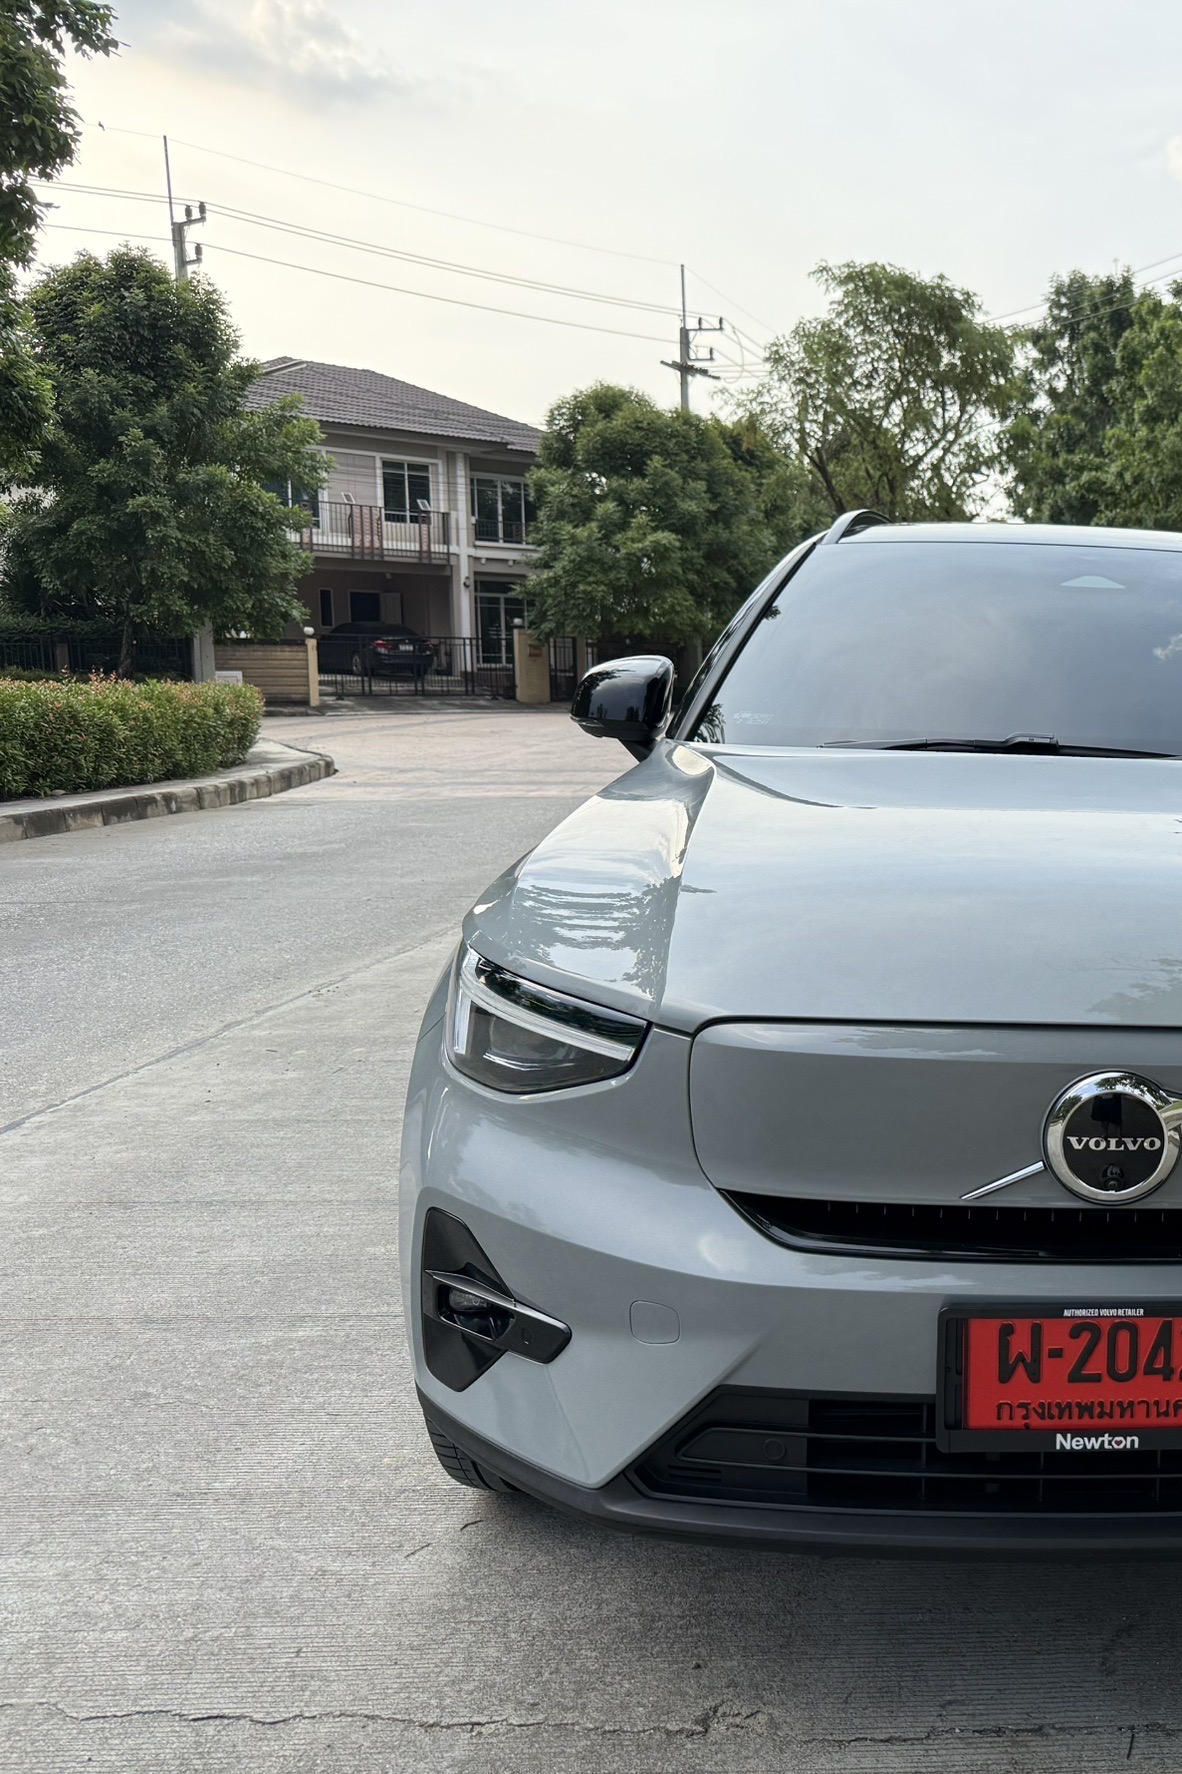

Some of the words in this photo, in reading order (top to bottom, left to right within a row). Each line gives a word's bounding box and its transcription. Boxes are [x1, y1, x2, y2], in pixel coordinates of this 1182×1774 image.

[1066, 1136, 1162, 1151] VOLVO
[1063, 1308, 1099, 1317] AUTHORIZED
[1099, 1308, 1117, 1316] VOLVO
[1117, 1308, 1145, 1316] RETAILER
[1055, 1432, 1139, 1450] Newton
